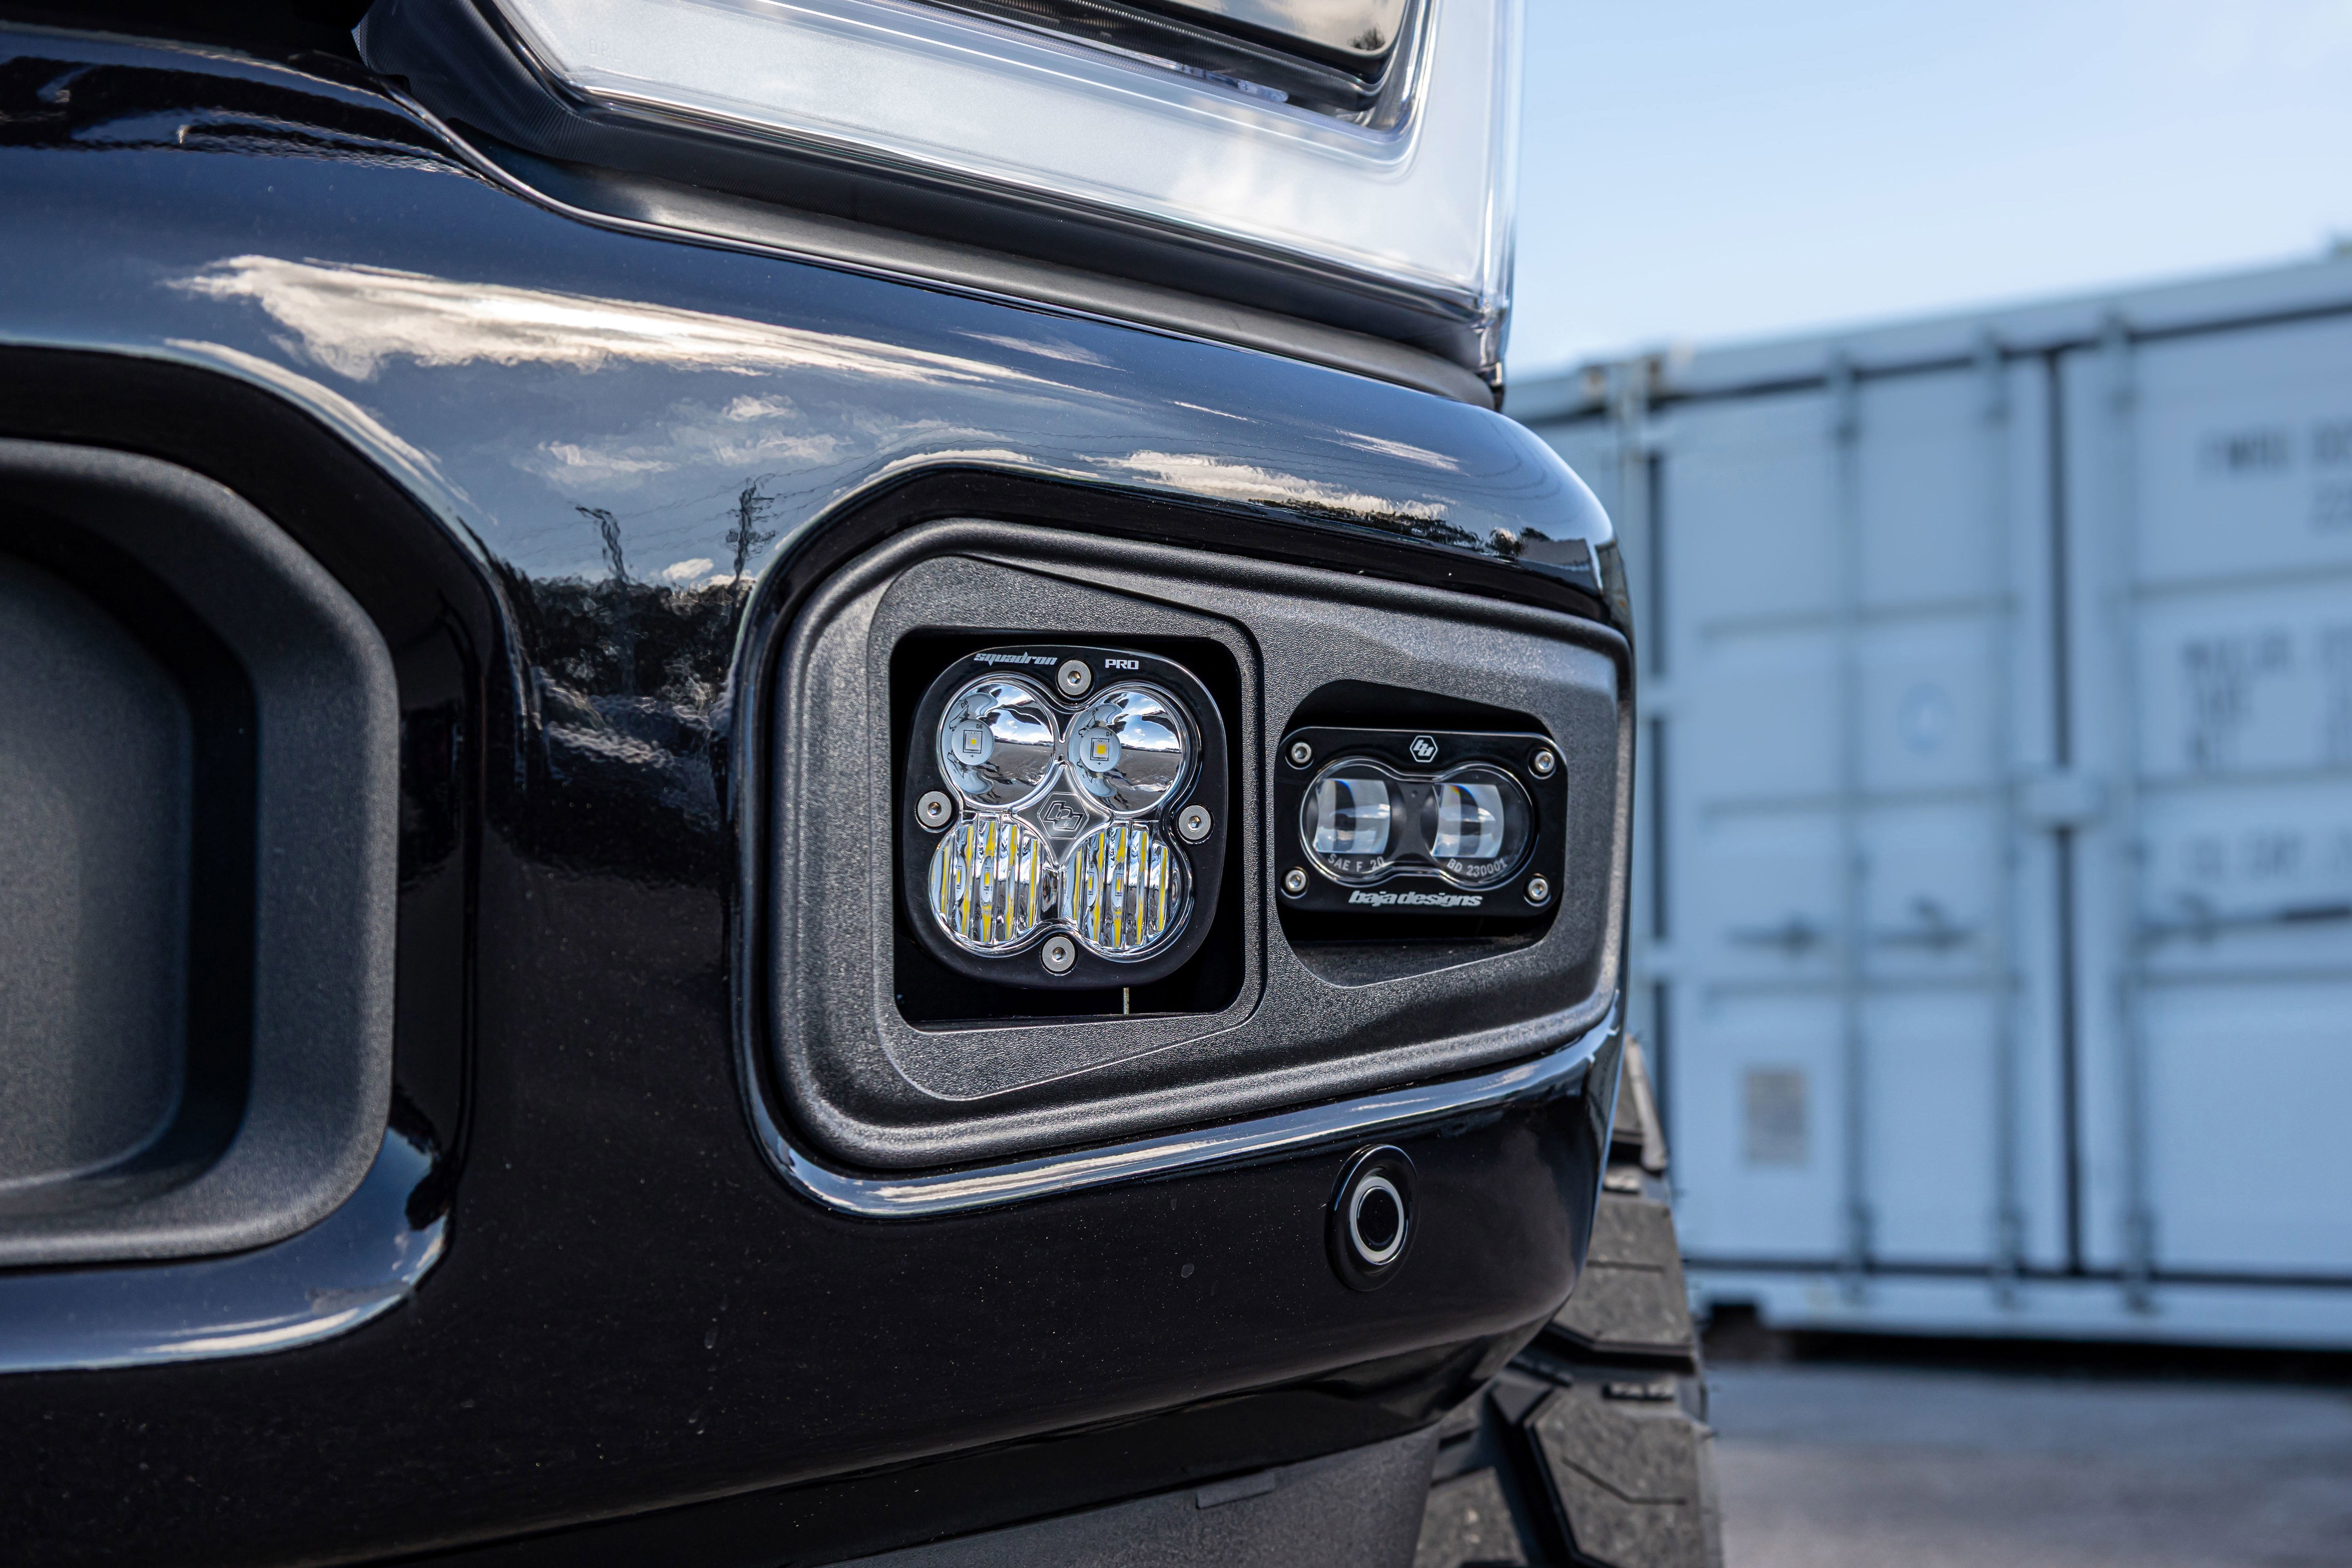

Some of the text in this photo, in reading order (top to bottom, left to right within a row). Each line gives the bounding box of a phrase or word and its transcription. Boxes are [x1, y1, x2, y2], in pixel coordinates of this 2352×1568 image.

[973, 652, 1139, 670] squadron PRO
[1327, 853, 1385, 872] SAE F 20
[1447, 857, 1508, 877] BD 230001
